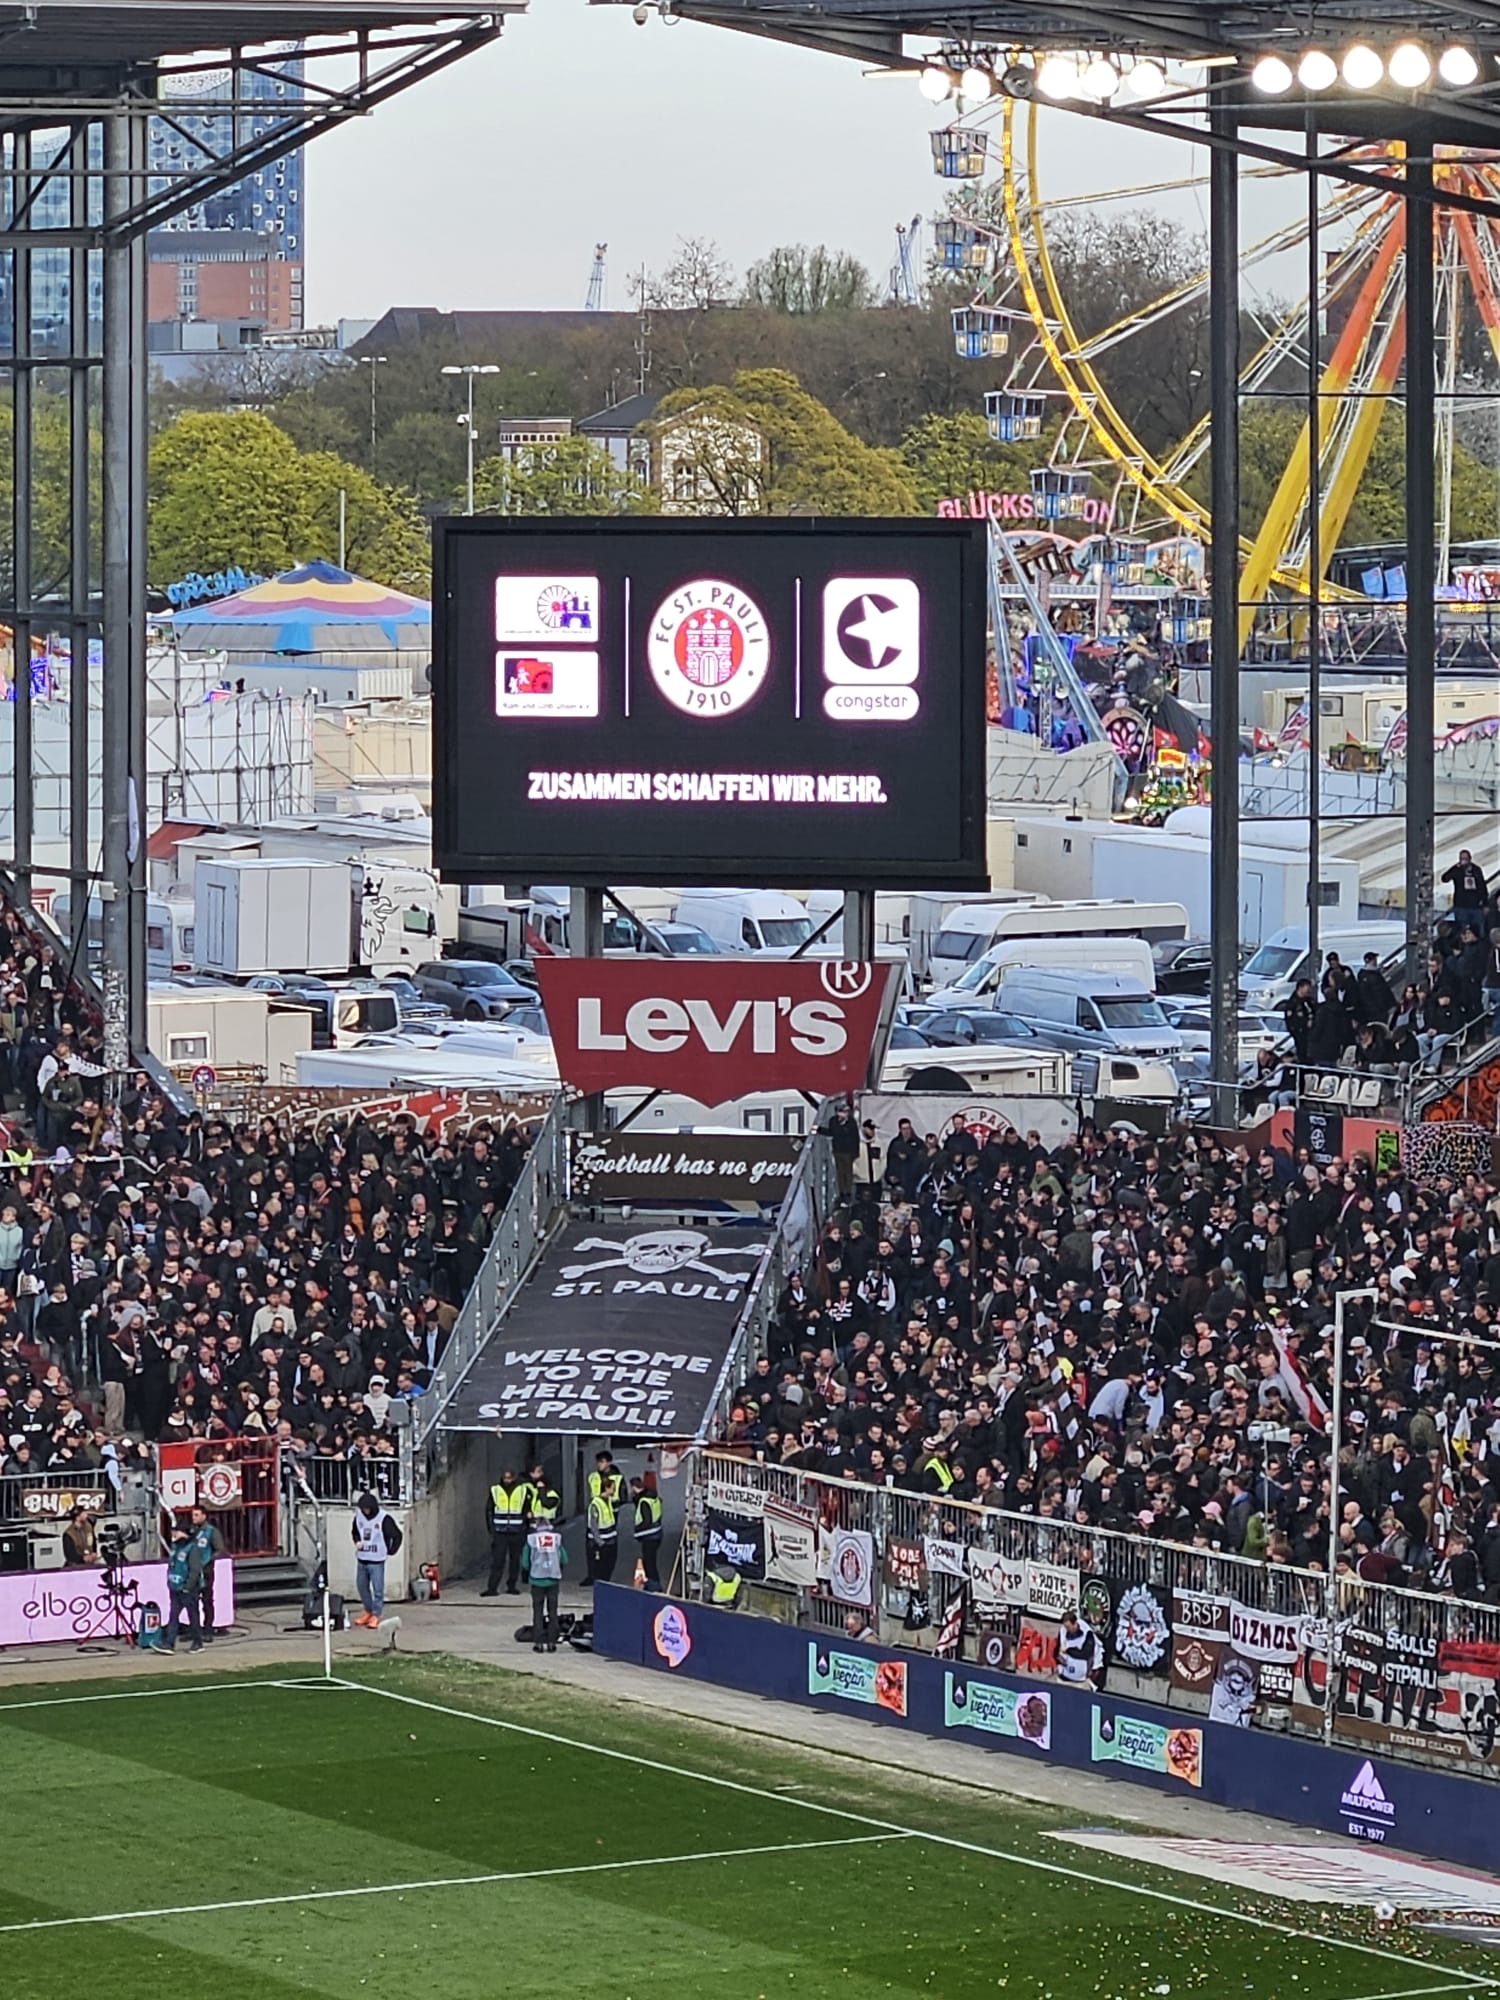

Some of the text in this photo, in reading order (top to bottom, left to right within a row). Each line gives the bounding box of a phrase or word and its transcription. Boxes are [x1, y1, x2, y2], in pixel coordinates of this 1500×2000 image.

[656, 587, 763, 644] FC ST. PAULI
[686, 690, 731, 709] 1910
[836, 695, 908, 712] congstar
[528, 772, 887, 803] ZUSAMMEN SCHAFFEN WIR MEHR.
[674, 1153, 715, 1174] has
[719, 1160, 747, 1175] no
[551, 1280, 741, 1302] ST. PAULI
[505, 1349, 712, 1373] WELCOME
[525, 1365, 672, 1387] TO THE
[501, 1383, 673, 1405] HELL OF
[478, 1401, 676, 1426] ST. PAULI!
[171, 1480, 186, 1494] C1
[1029, 1587, 1077, 1612] BRIGADE
[1181, 1600, 1222, 1629] BRSP
[1385, 1627, 1437, 1657] SKULLS
[833, 1668, 865, 1689] vegan
[970, 1699, 1004, 1721] vegan
[1119, 1734, 1155, 1756] vegan
[1341, 1791, 1395, 1815] MULTIPOWER
